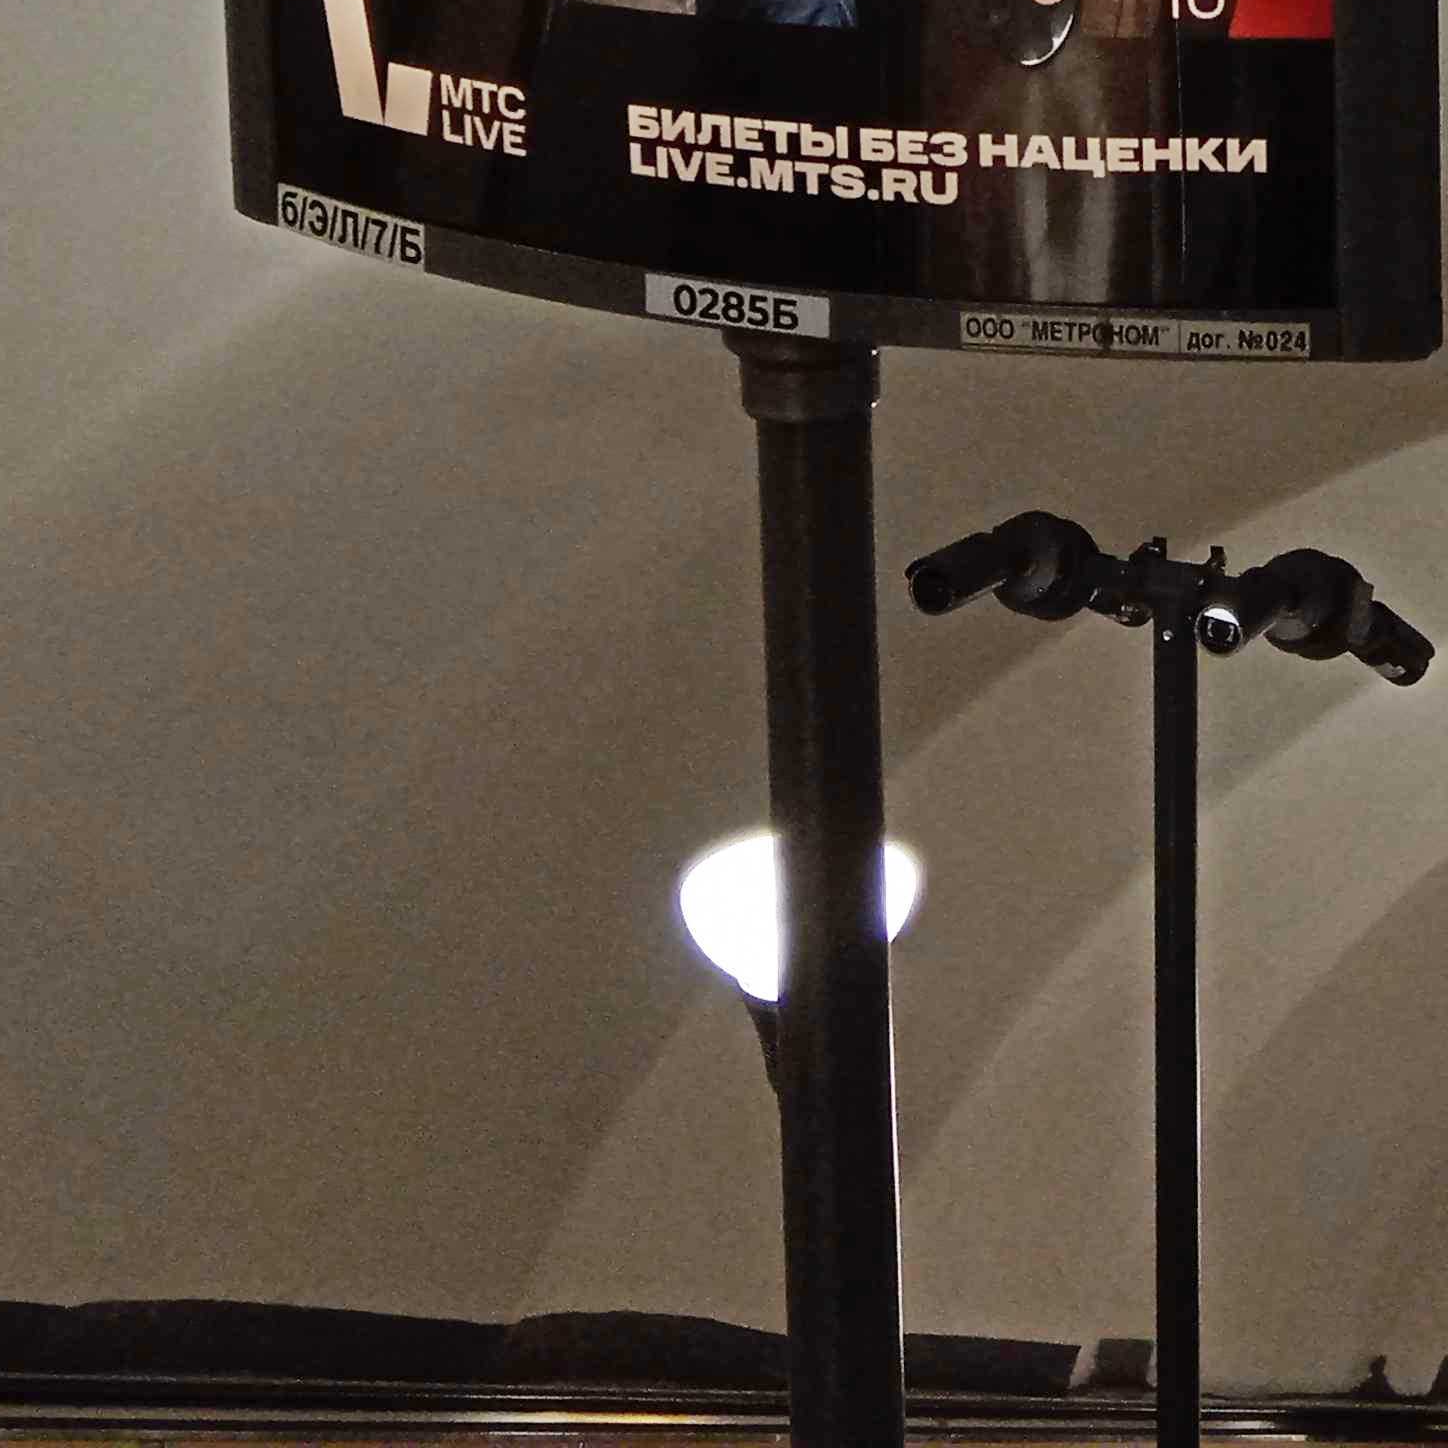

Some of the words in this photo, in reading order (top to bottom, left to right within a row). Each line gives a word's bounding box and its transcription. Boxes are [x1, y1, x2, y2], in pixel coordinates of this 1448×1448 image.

[439, 72, 526, 120] МТС
[441, 109, 527, 158] LIVE
[627, 104, 849, 161] БИЛЕТЫ
[859, 129, 968, 167] БЕЗ
[979, 133, 1269, 179] НАЦЕНКИ
[628, 142, 959, 206] LIVE.MTS.RU
[965, 316, 1016, 340] ООО
[1186, 330, 1232, 352] дог.
[1237, 330, 1307, 354] №024
